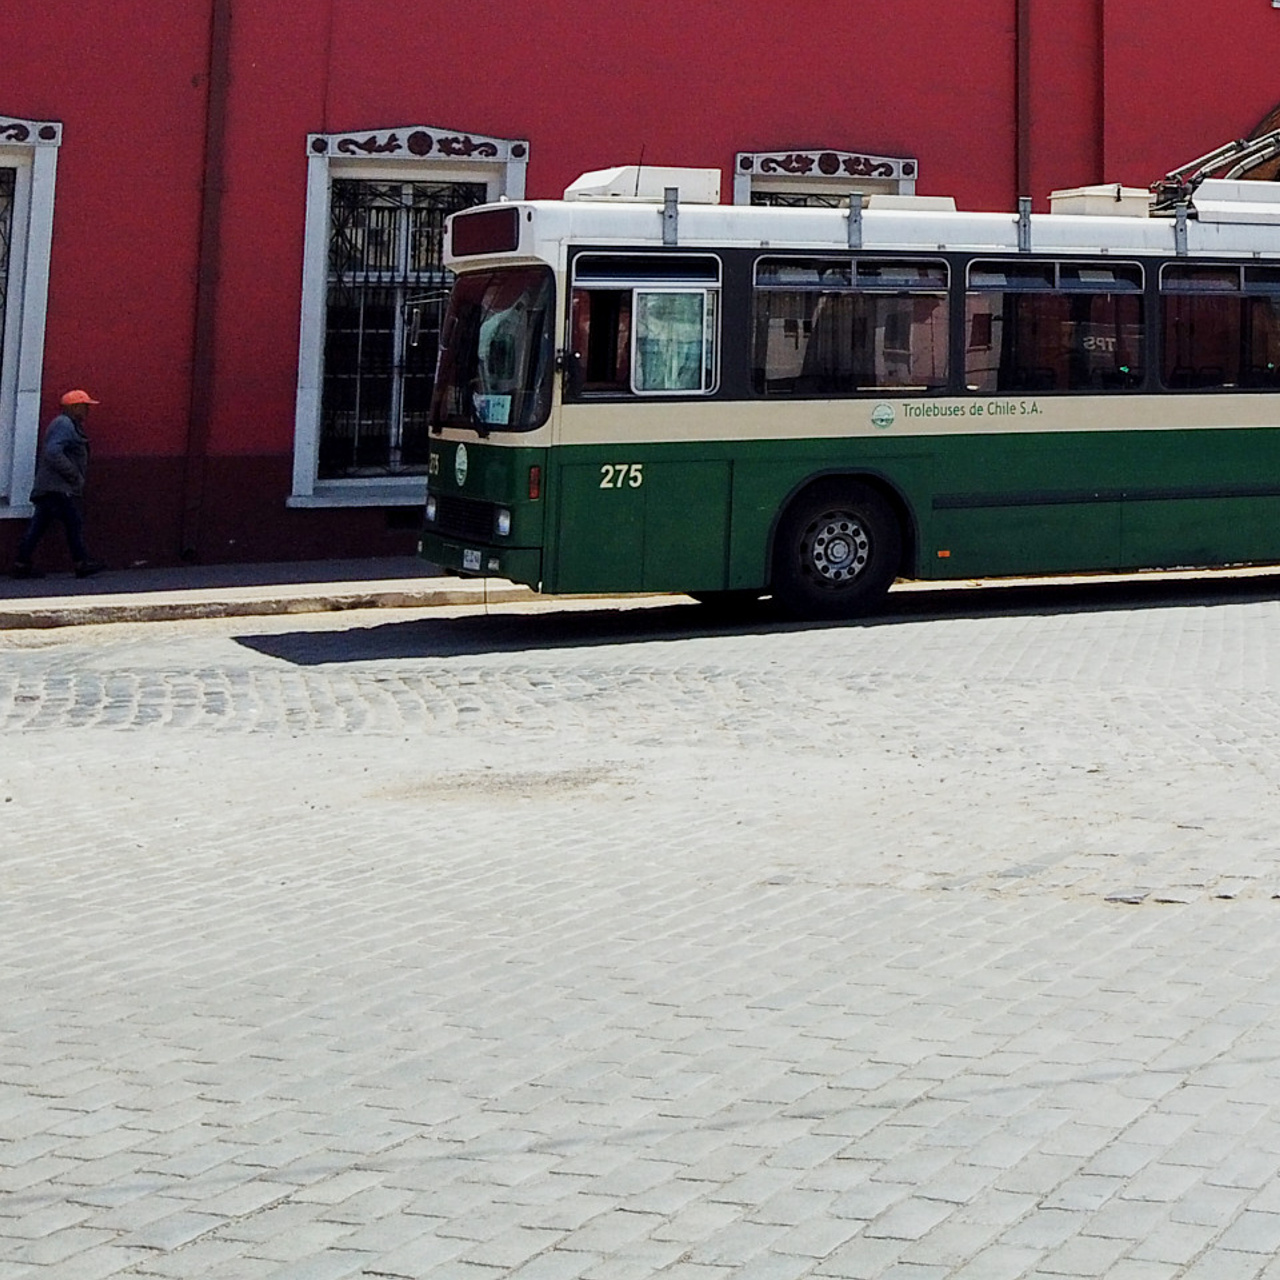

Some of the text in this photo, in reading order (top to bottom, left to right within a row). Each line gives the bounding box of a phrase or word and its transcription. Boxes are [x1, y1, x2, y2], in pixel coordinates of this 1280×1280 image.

[902, 401, 1043, 417] Trolebuses de Chile S.A.
[599, 464, 643, 488] 275
